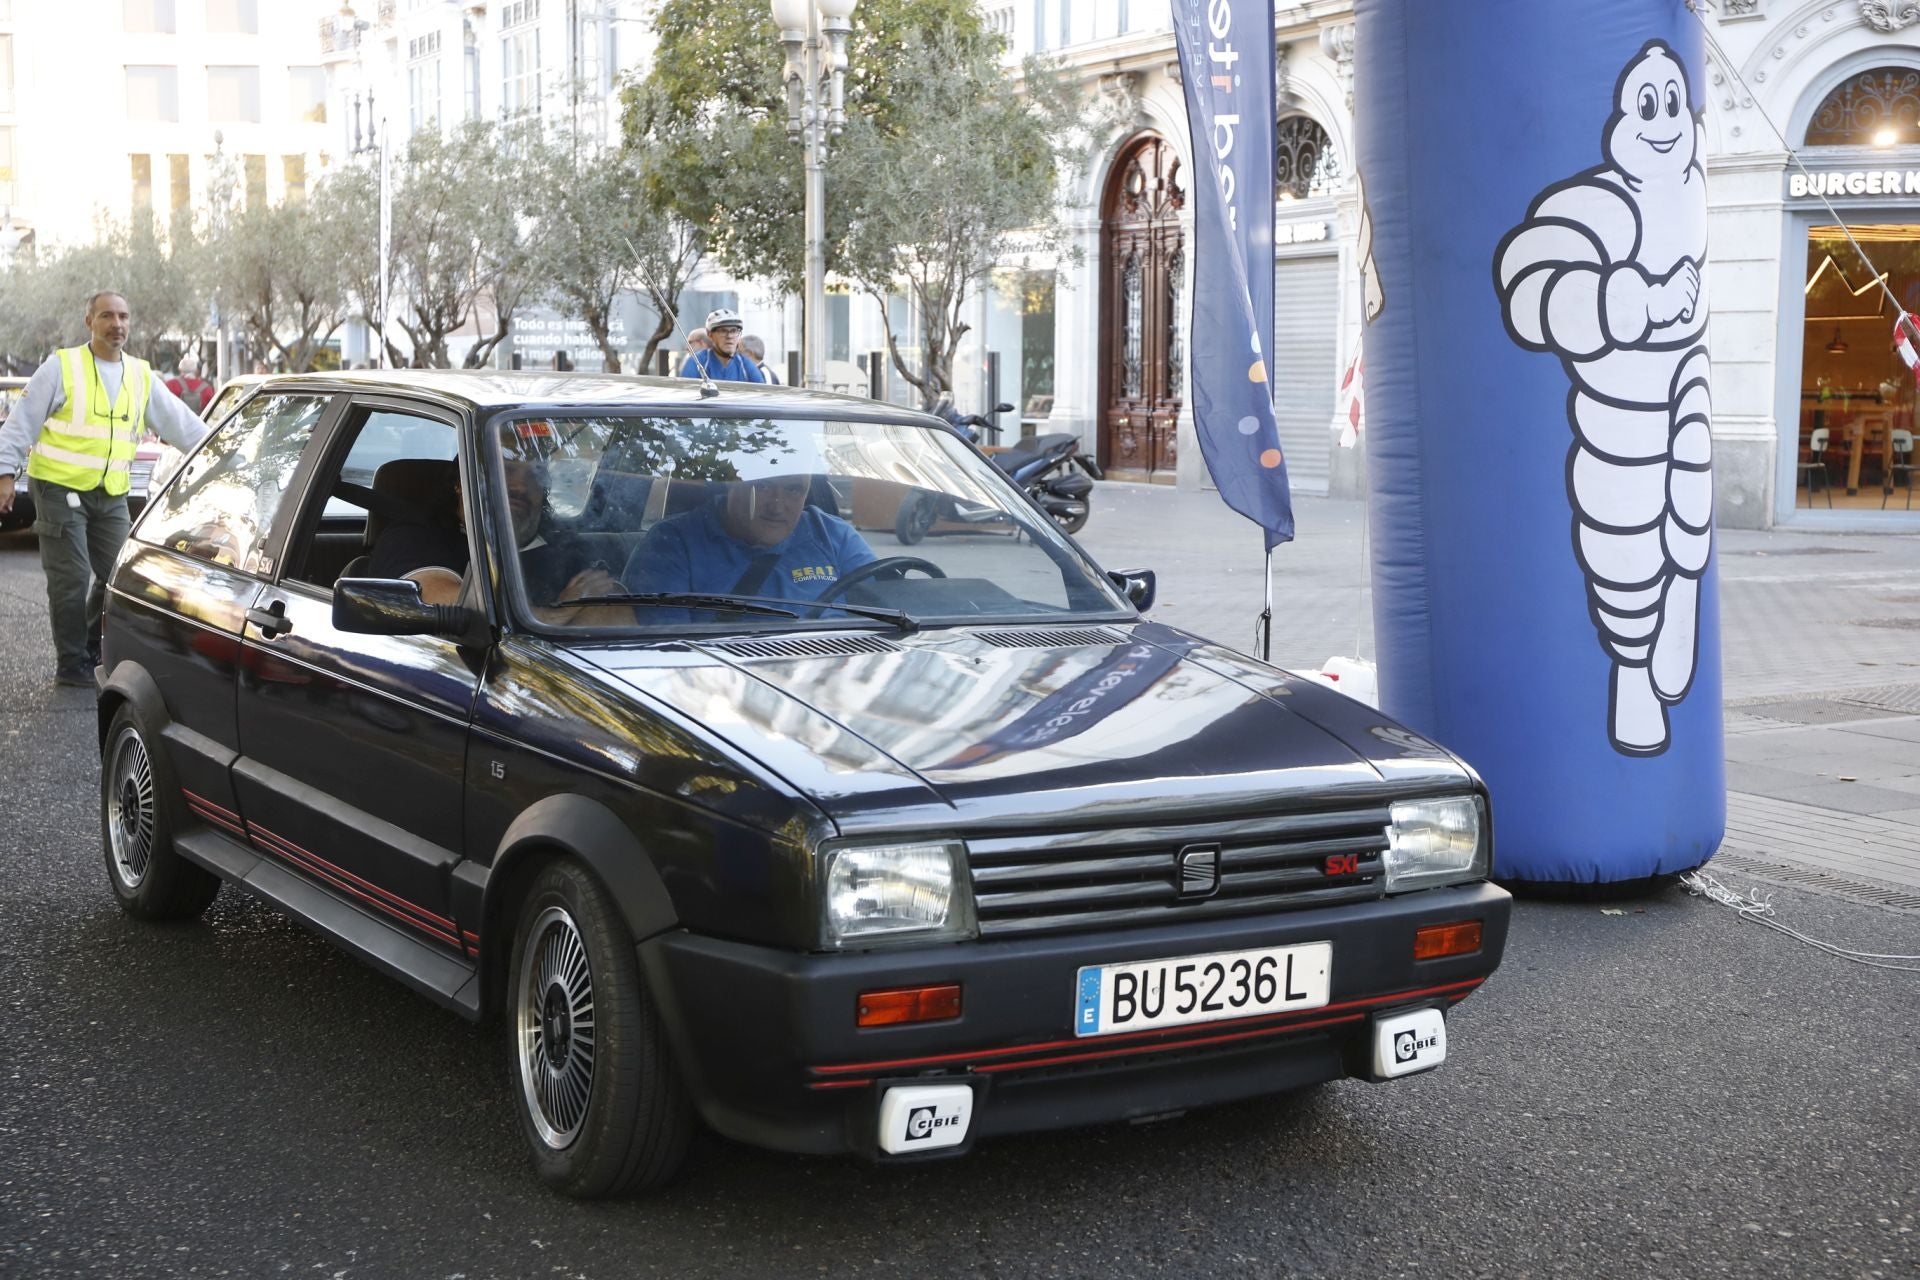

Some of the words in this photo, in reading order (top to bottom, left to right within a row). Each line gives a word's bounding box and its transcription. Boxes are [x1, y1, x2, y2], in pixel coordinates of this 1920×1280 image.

[1789, 171, 1902, 197] BURGER
[513, 317, 545, 330] Todo
[512, 333, 561, 345] cuando
[791, 565, 835, 578] SEAT
[1083, 1007, 1096, 1024] E
